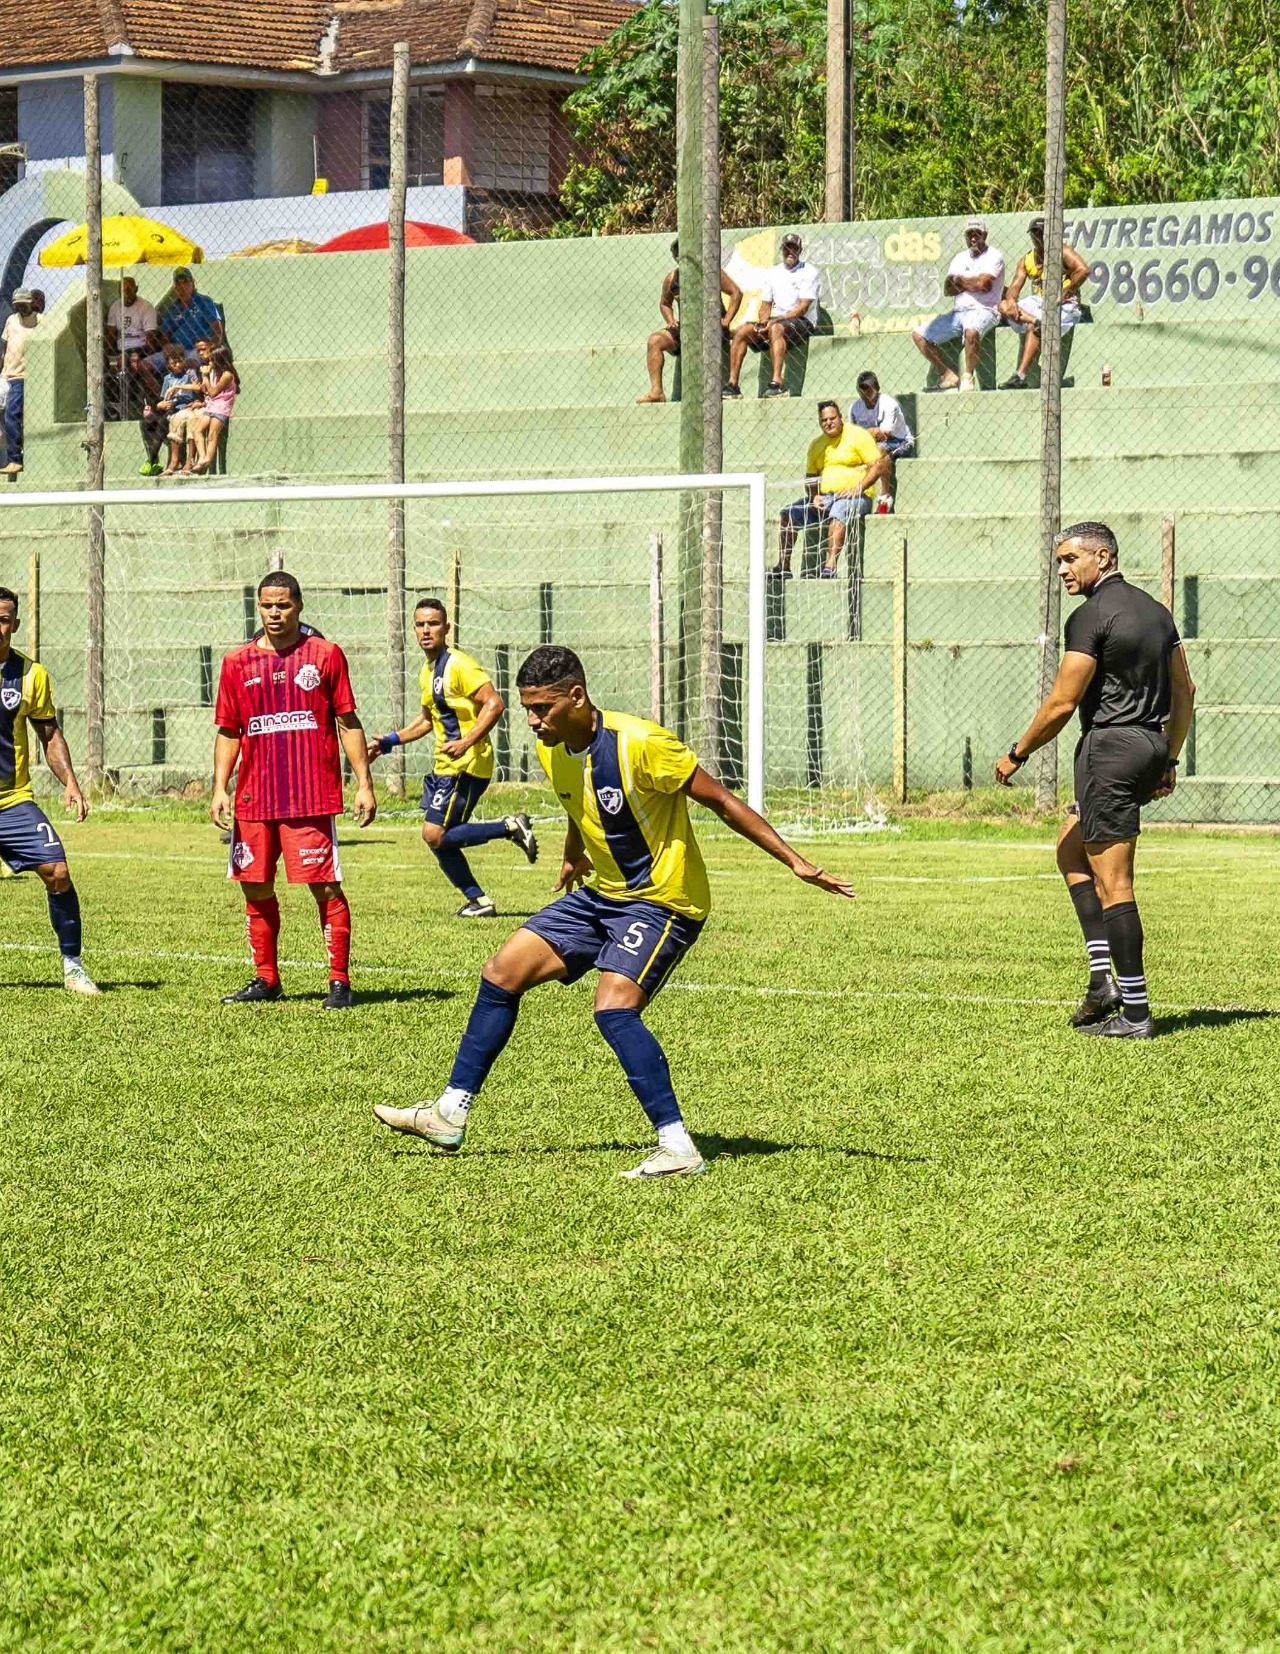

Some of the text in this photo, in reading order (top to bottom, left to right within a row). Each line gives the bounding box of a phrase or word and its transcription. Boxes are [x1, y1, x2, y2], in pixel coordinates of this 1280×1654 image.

[884, 225, 942, 262] das
[432, 788, 446, 808] 6
[622, 921, 644, 949] 5
